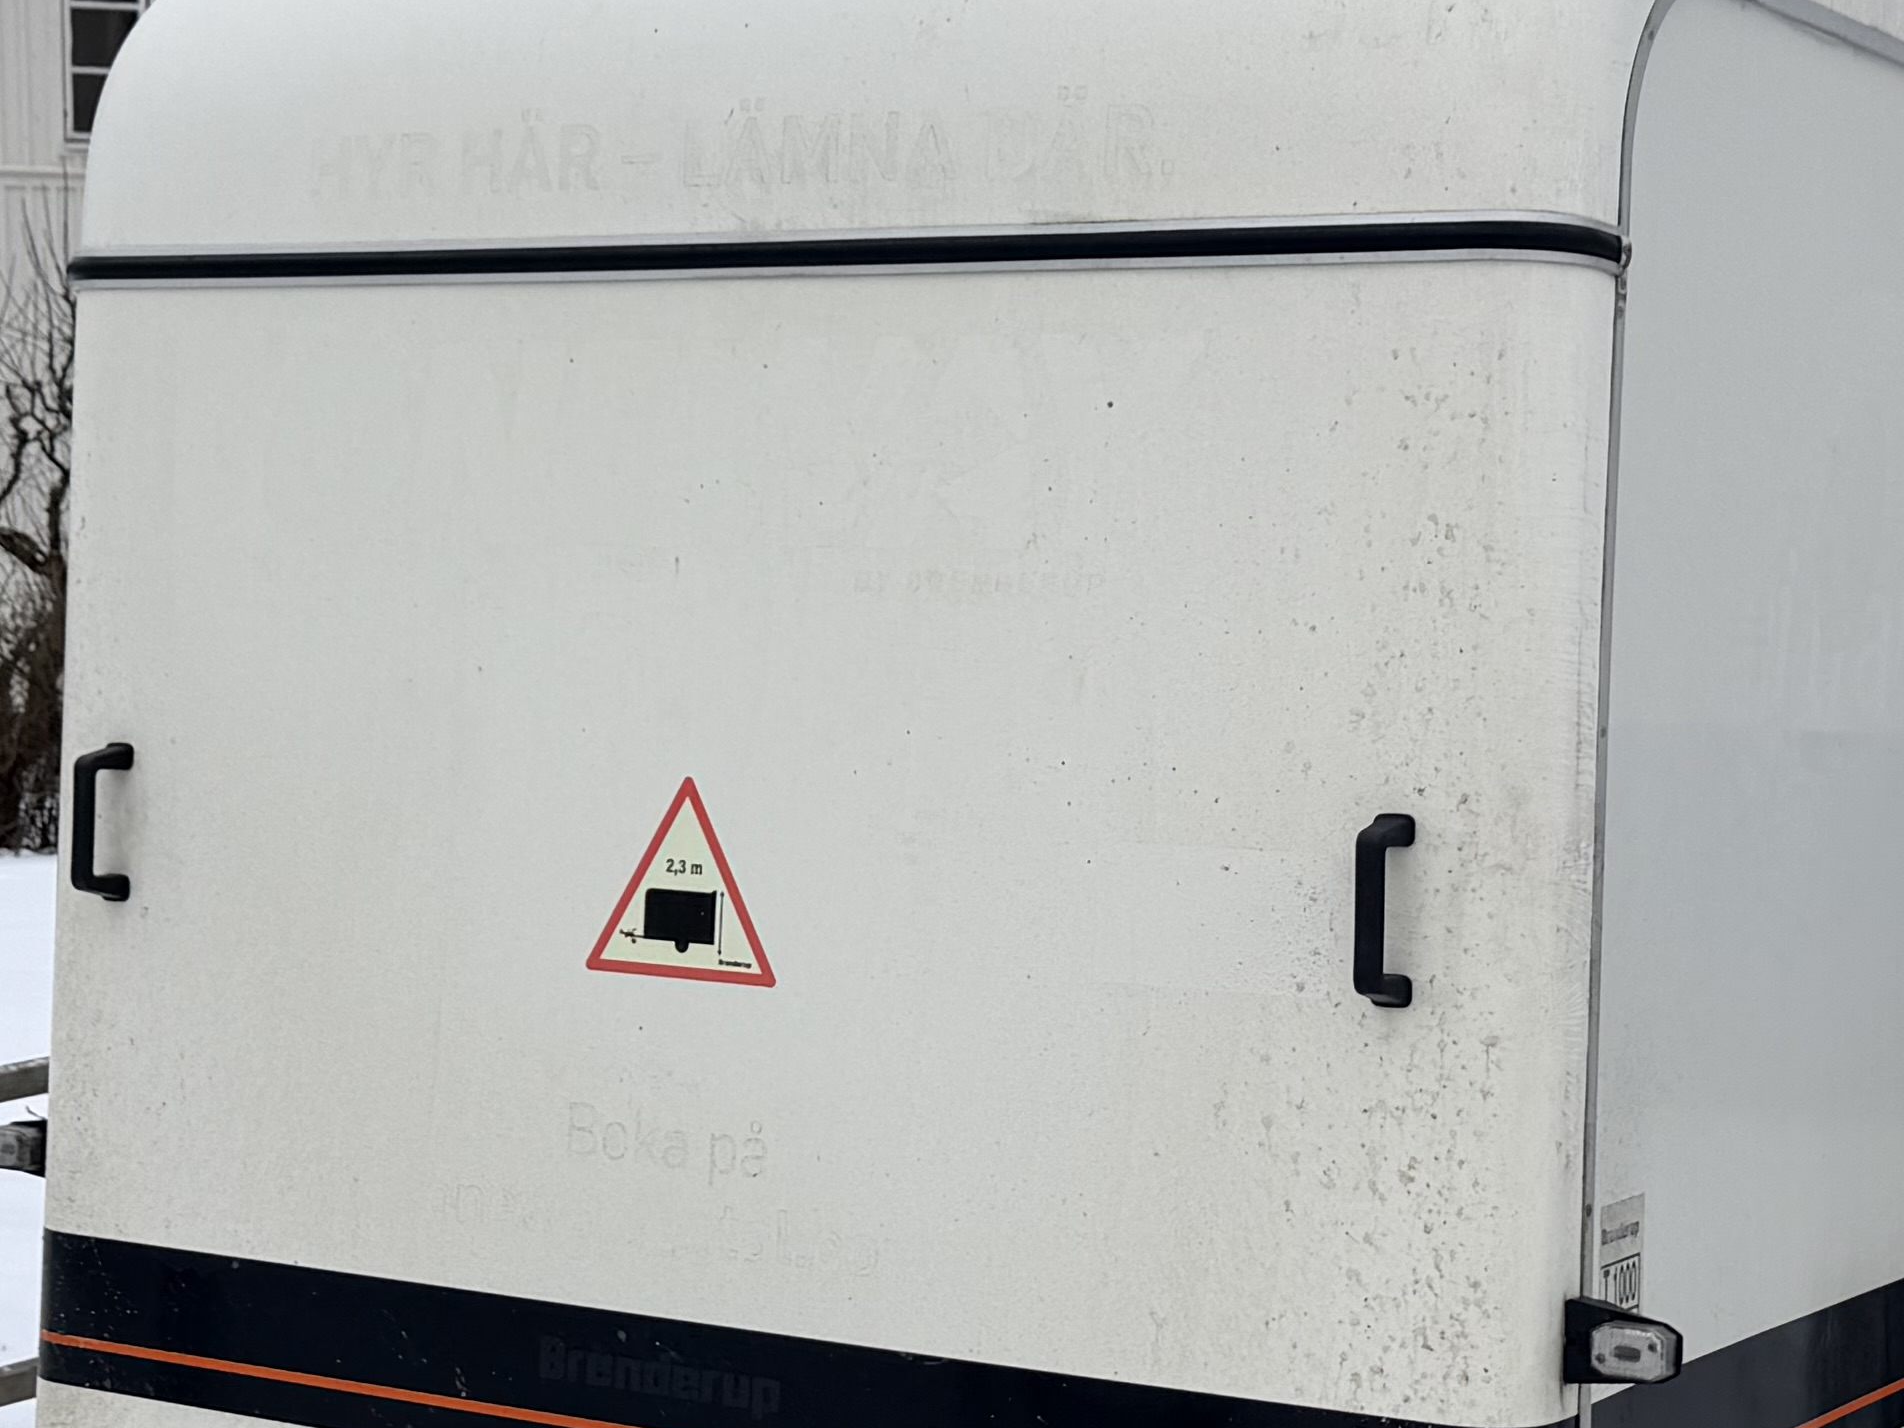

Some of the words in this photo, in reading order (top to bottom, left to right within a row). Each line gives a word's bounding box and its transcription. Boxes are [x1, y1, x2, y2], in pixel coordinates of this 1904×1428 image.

[458, 107, 603, 195] HÄR
[682, 96, 958, 193] LÄMNA
[665, 858, 687, 876] 2,3
[690, 863, 703, 875] m
[539, 1336, 781, 1421] Brenderup
